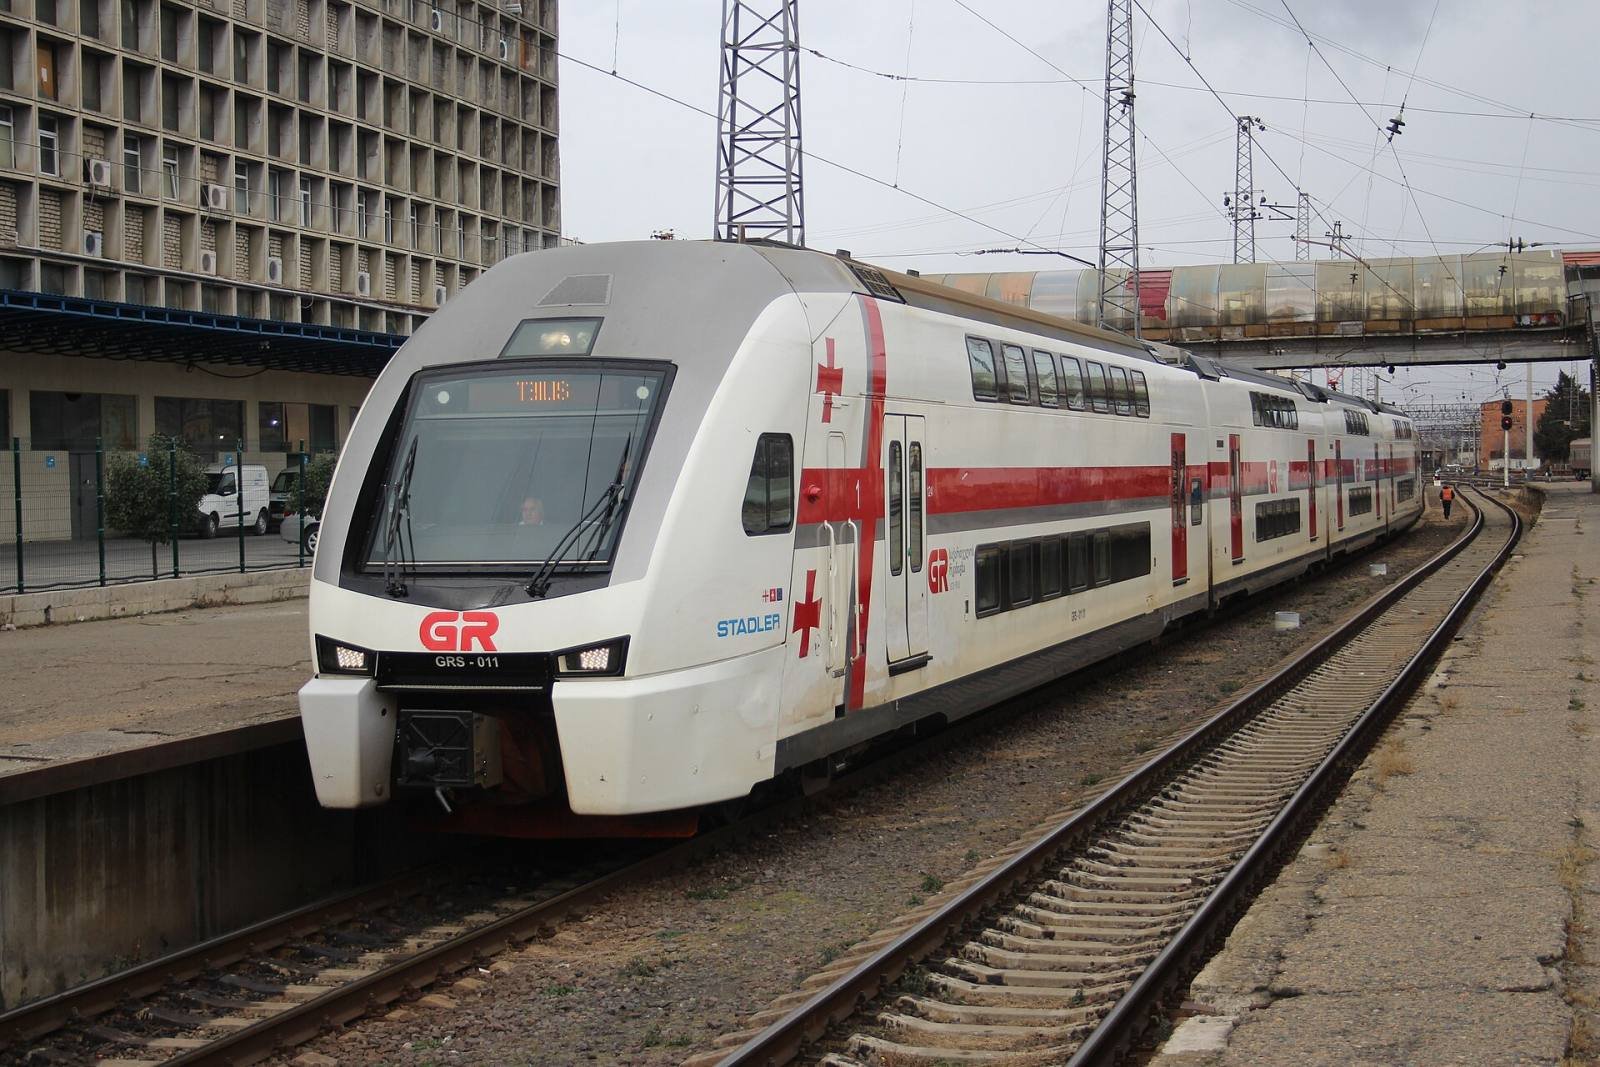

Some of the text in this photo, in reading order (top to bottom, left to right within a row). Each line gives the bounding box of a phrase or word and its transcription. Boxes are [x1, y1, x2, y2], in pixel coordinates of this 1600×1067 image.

[928, 548, 949, 594] GR
[419, 611, 500, 652] GR
[717, 613, 780, 638] STADLER
[435, 655, 466, 668] GRS
[477, 656, 499, 668] 011
